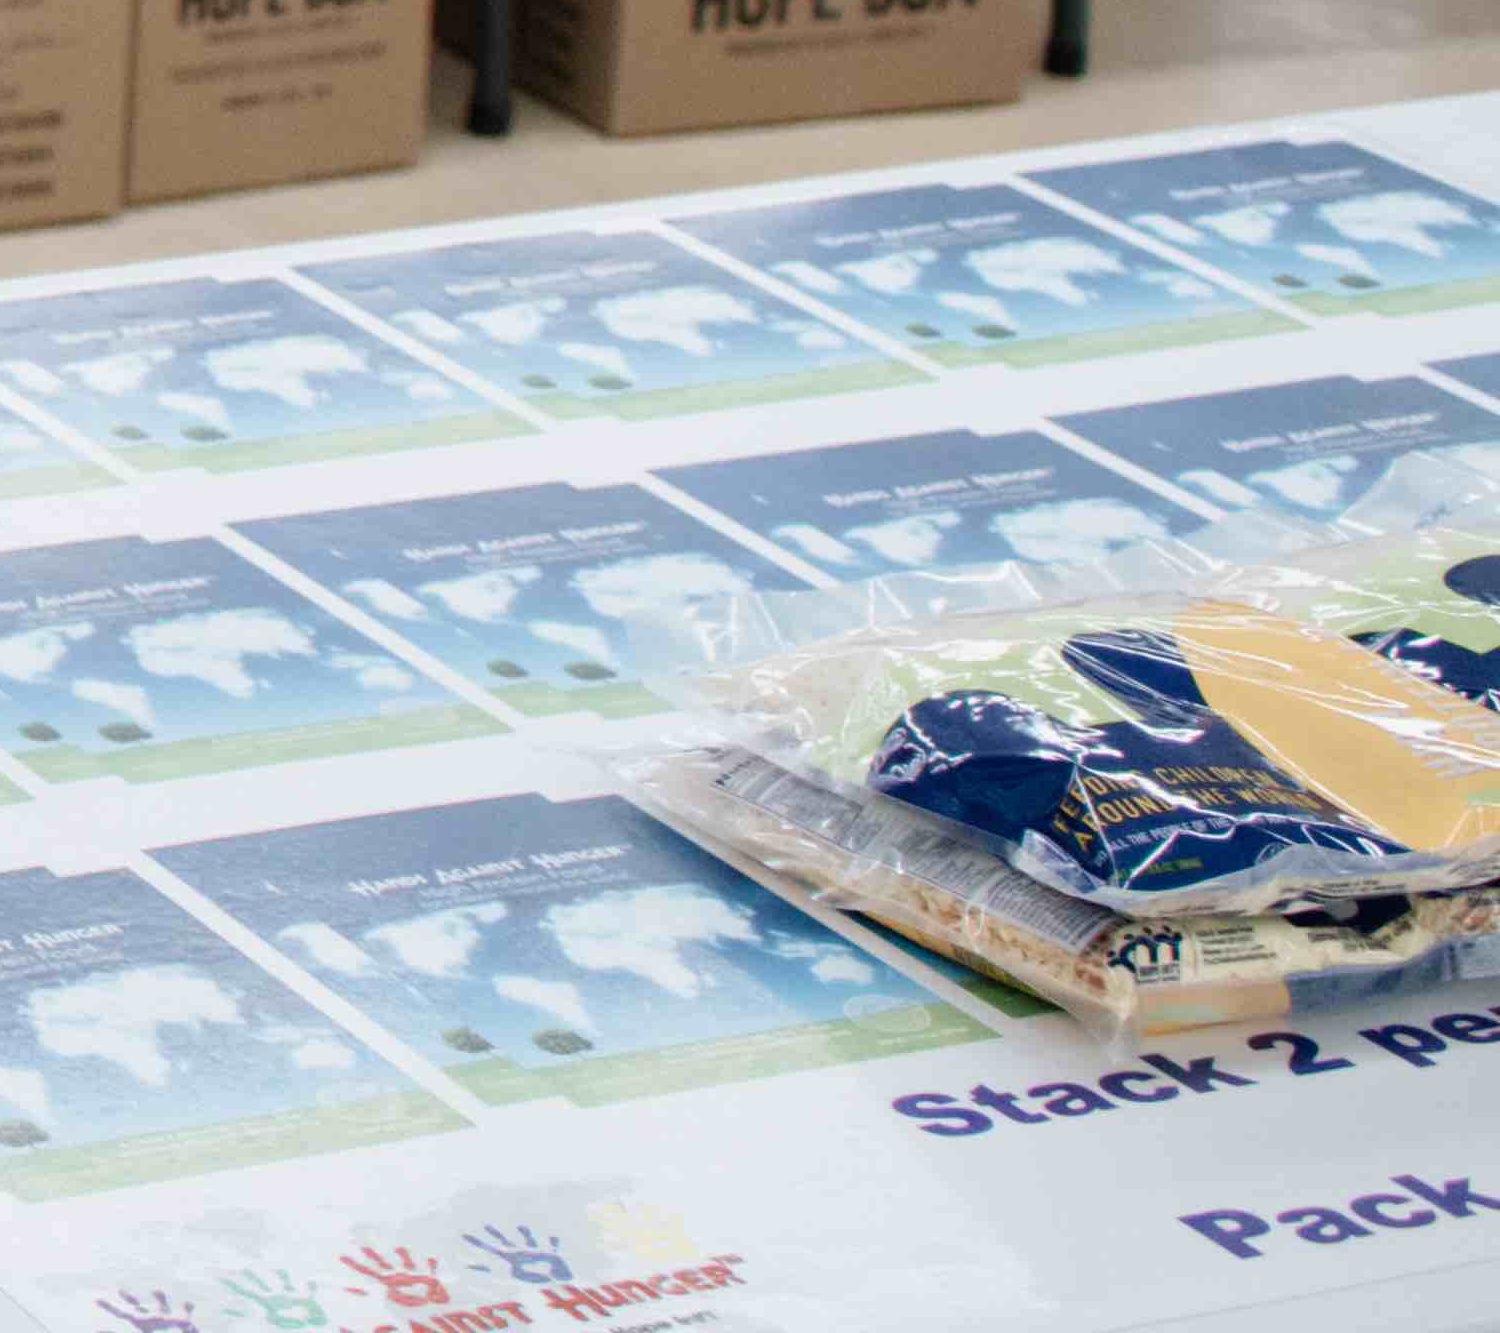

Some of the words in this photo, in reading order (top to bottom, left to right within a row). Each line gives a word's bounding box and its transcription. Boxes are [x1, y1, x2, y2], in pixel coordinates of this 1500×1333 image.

[891, 1051, 1260, 1137] Stack
[1248, 1032, 1355, 1076] 2
[1357, 1007, 1500, 1068] pe
[1176, 1173, 1500, 1260] Pack
